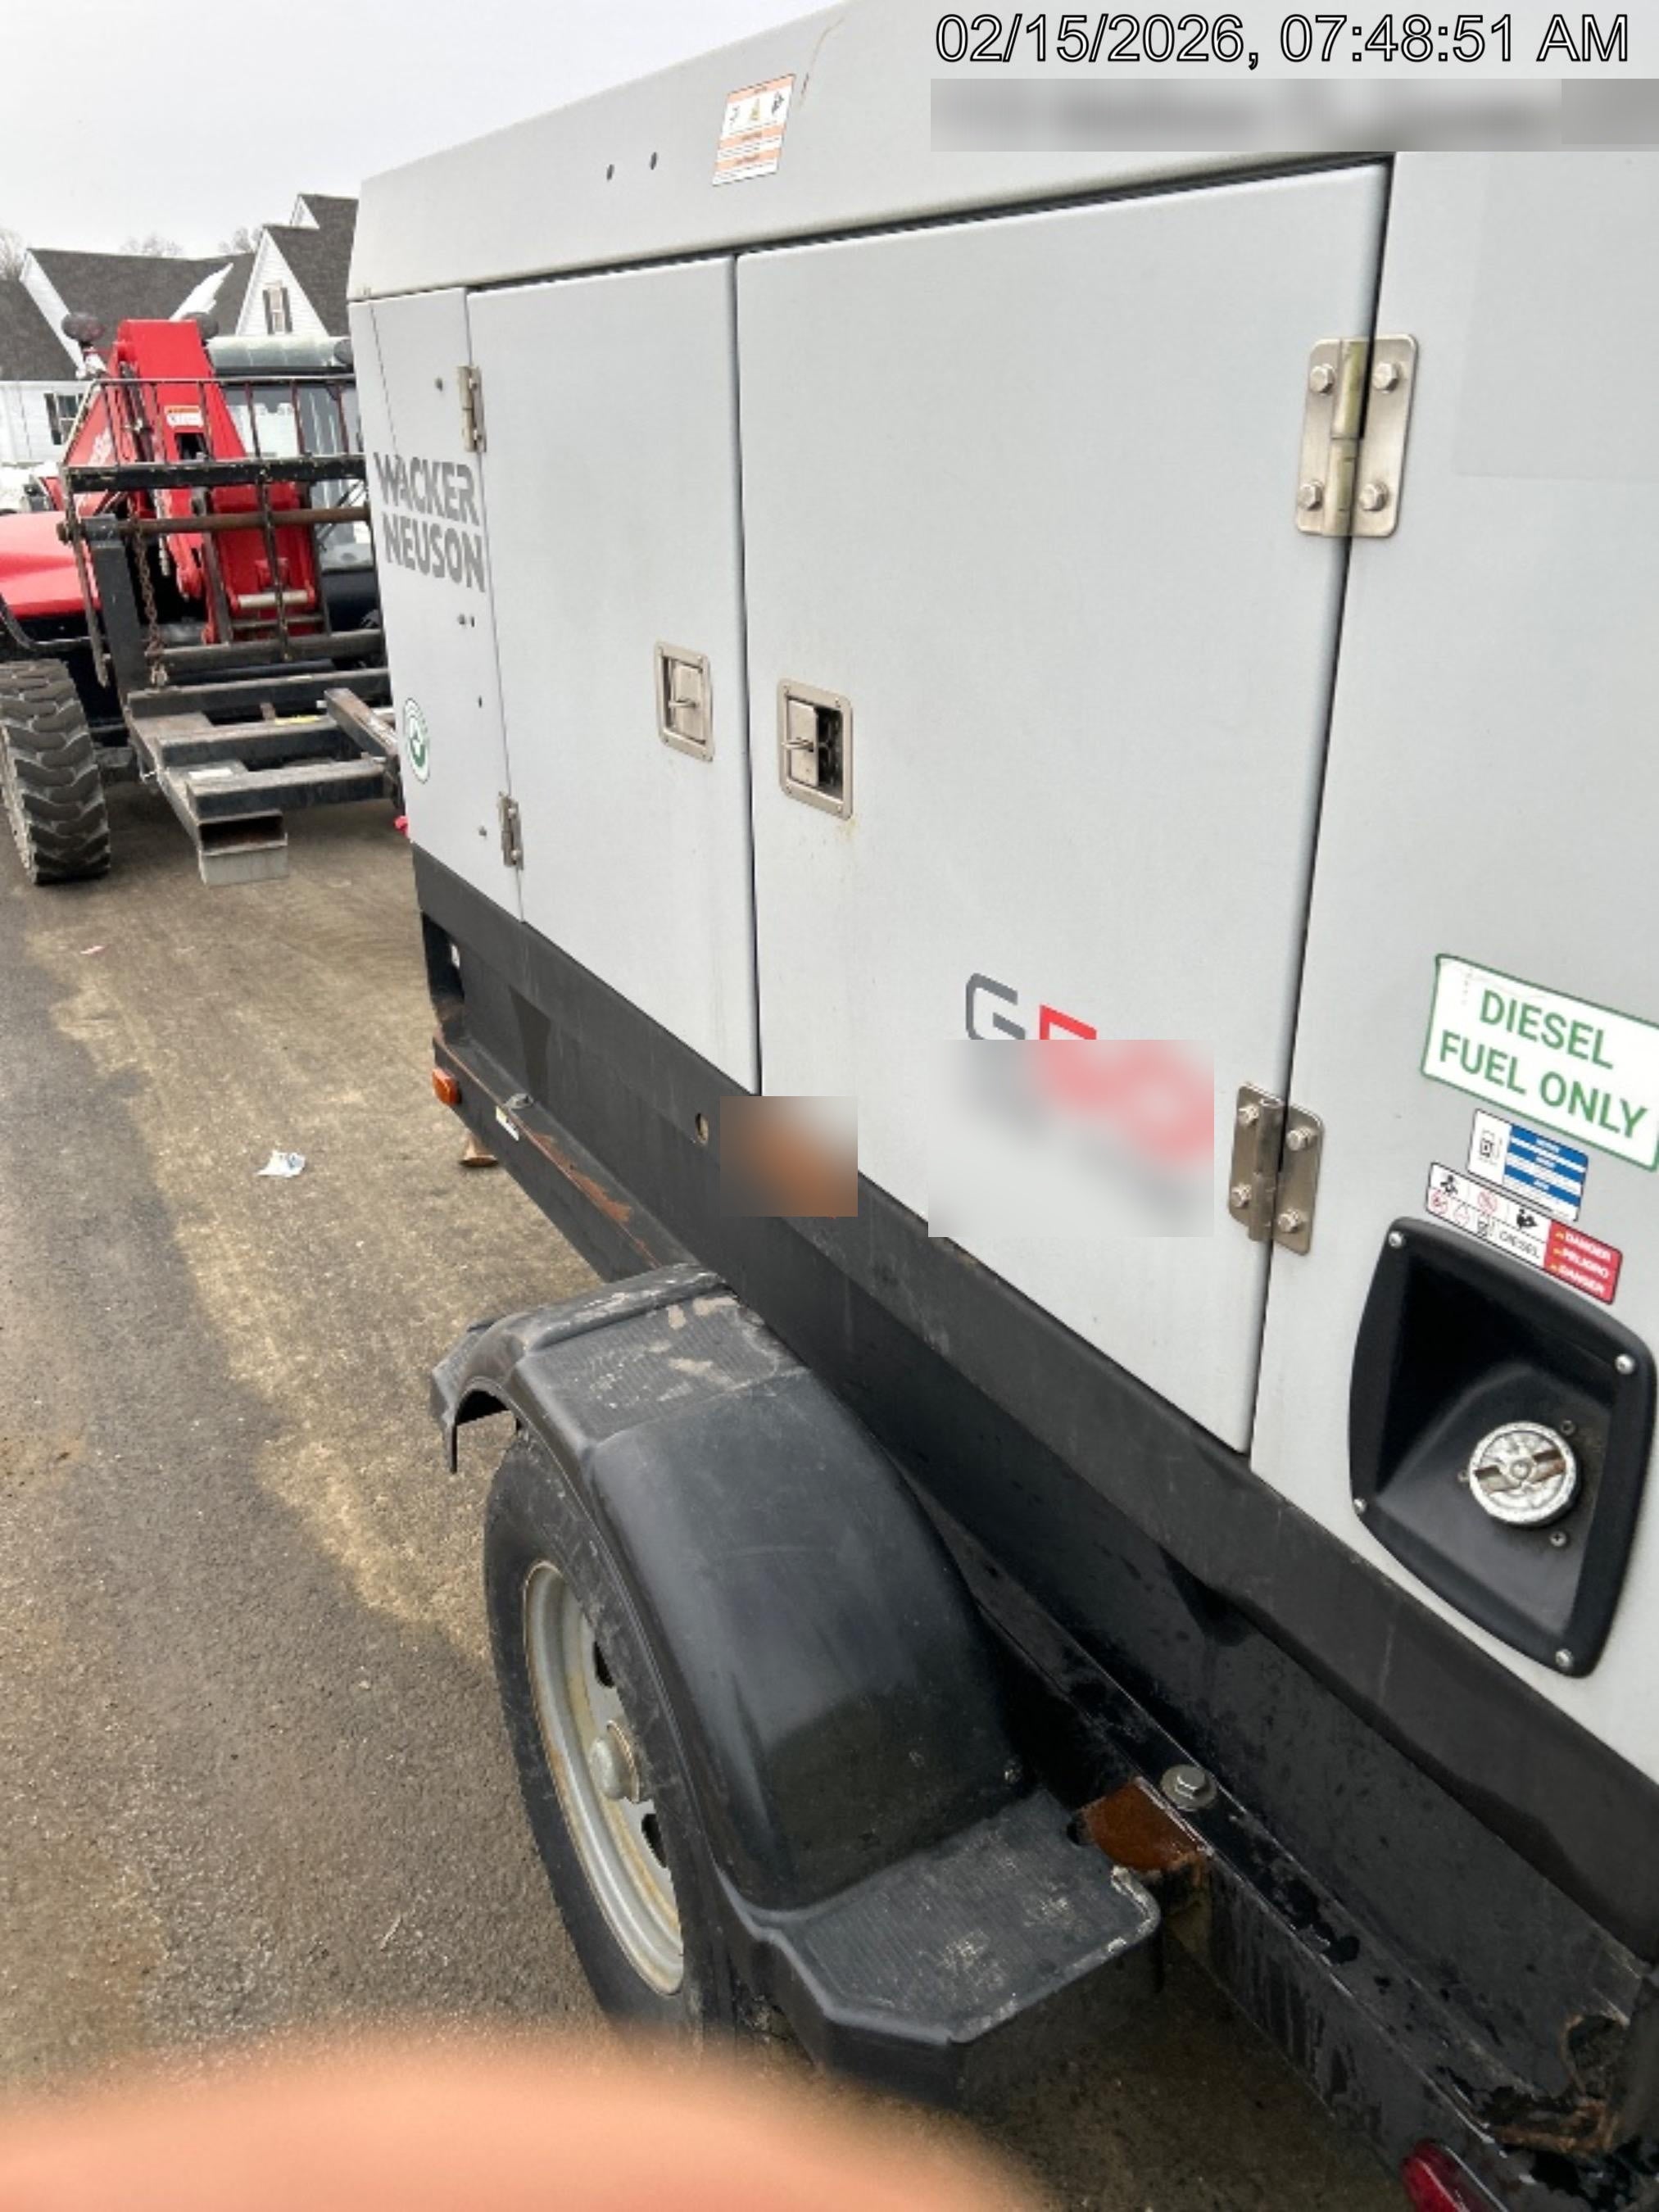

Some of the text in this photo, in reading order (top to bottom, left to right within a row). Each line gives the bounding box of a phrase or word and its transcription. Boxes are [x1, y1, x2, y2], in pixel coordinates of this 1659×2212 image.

[374, 452, 479, 526] WACKER
[383, 512, 485, 592] NEUSON
[1480, 988, 1614, 1069] DIESEL
[1439, 1030, 1649, 1139] FUEL ONLY
[1565, 1229, 1611, 1261] DANGER
